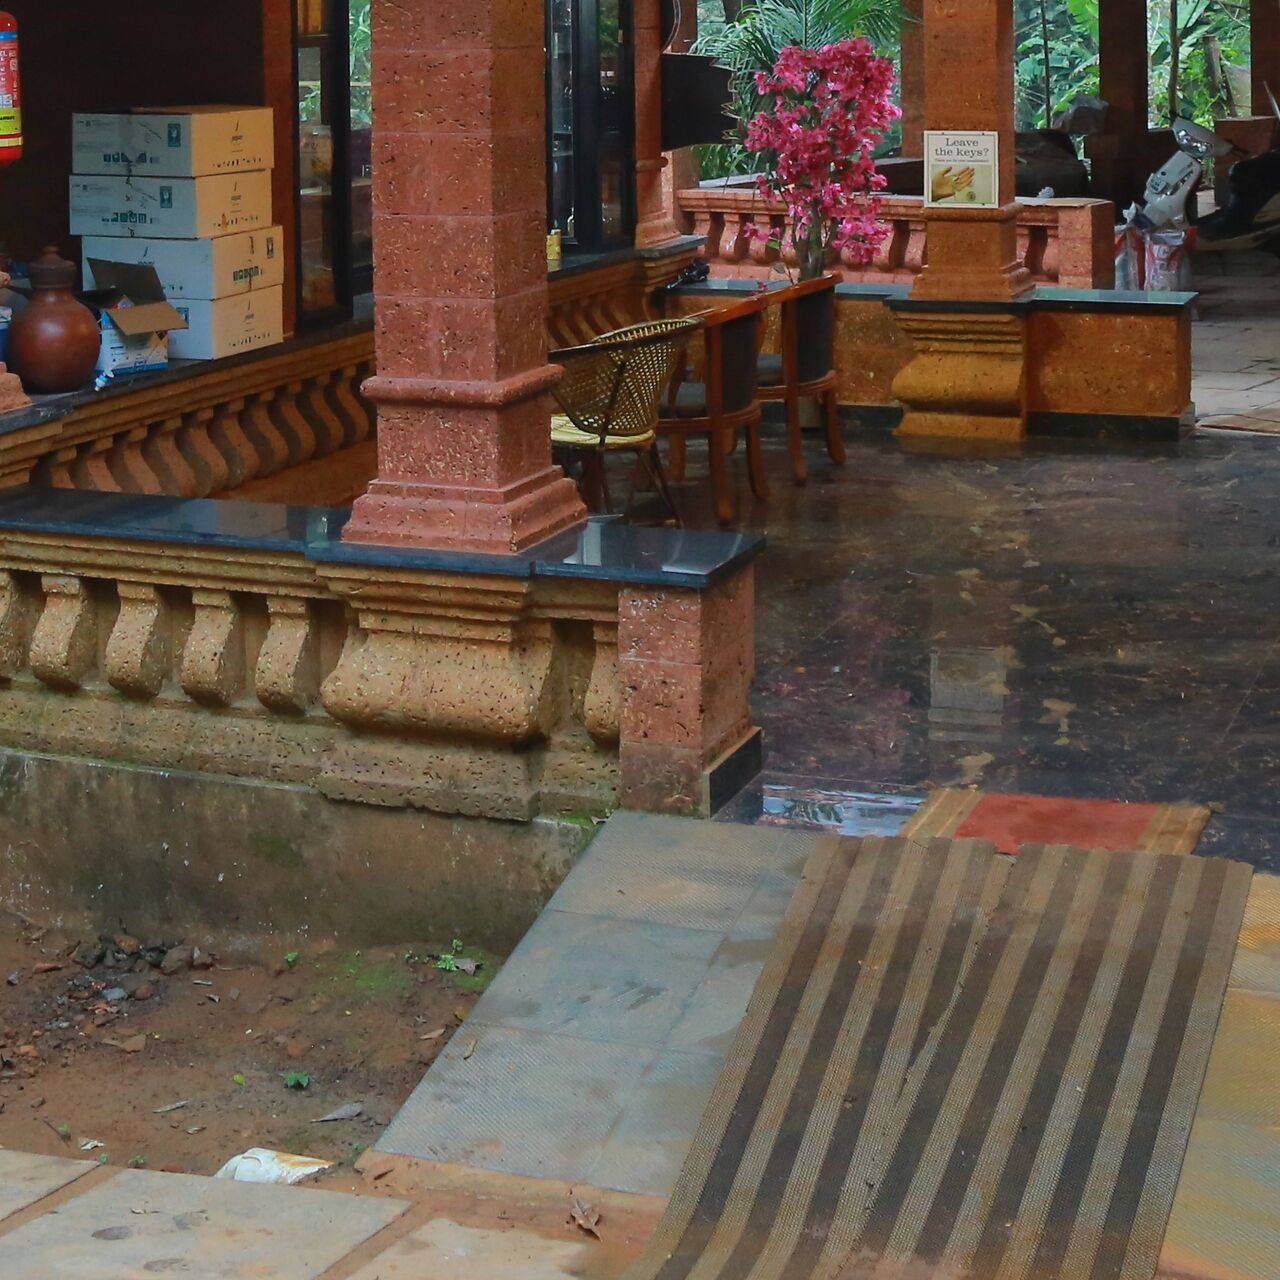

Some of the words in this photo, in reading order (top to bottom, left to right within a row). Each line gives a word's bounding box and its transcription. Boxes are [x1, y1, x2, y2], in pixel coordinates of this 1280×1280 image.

[945, 138, 979, 147] Leave
[935, 147, 953, 156] the
[956, 148, 989, 158] keys?
